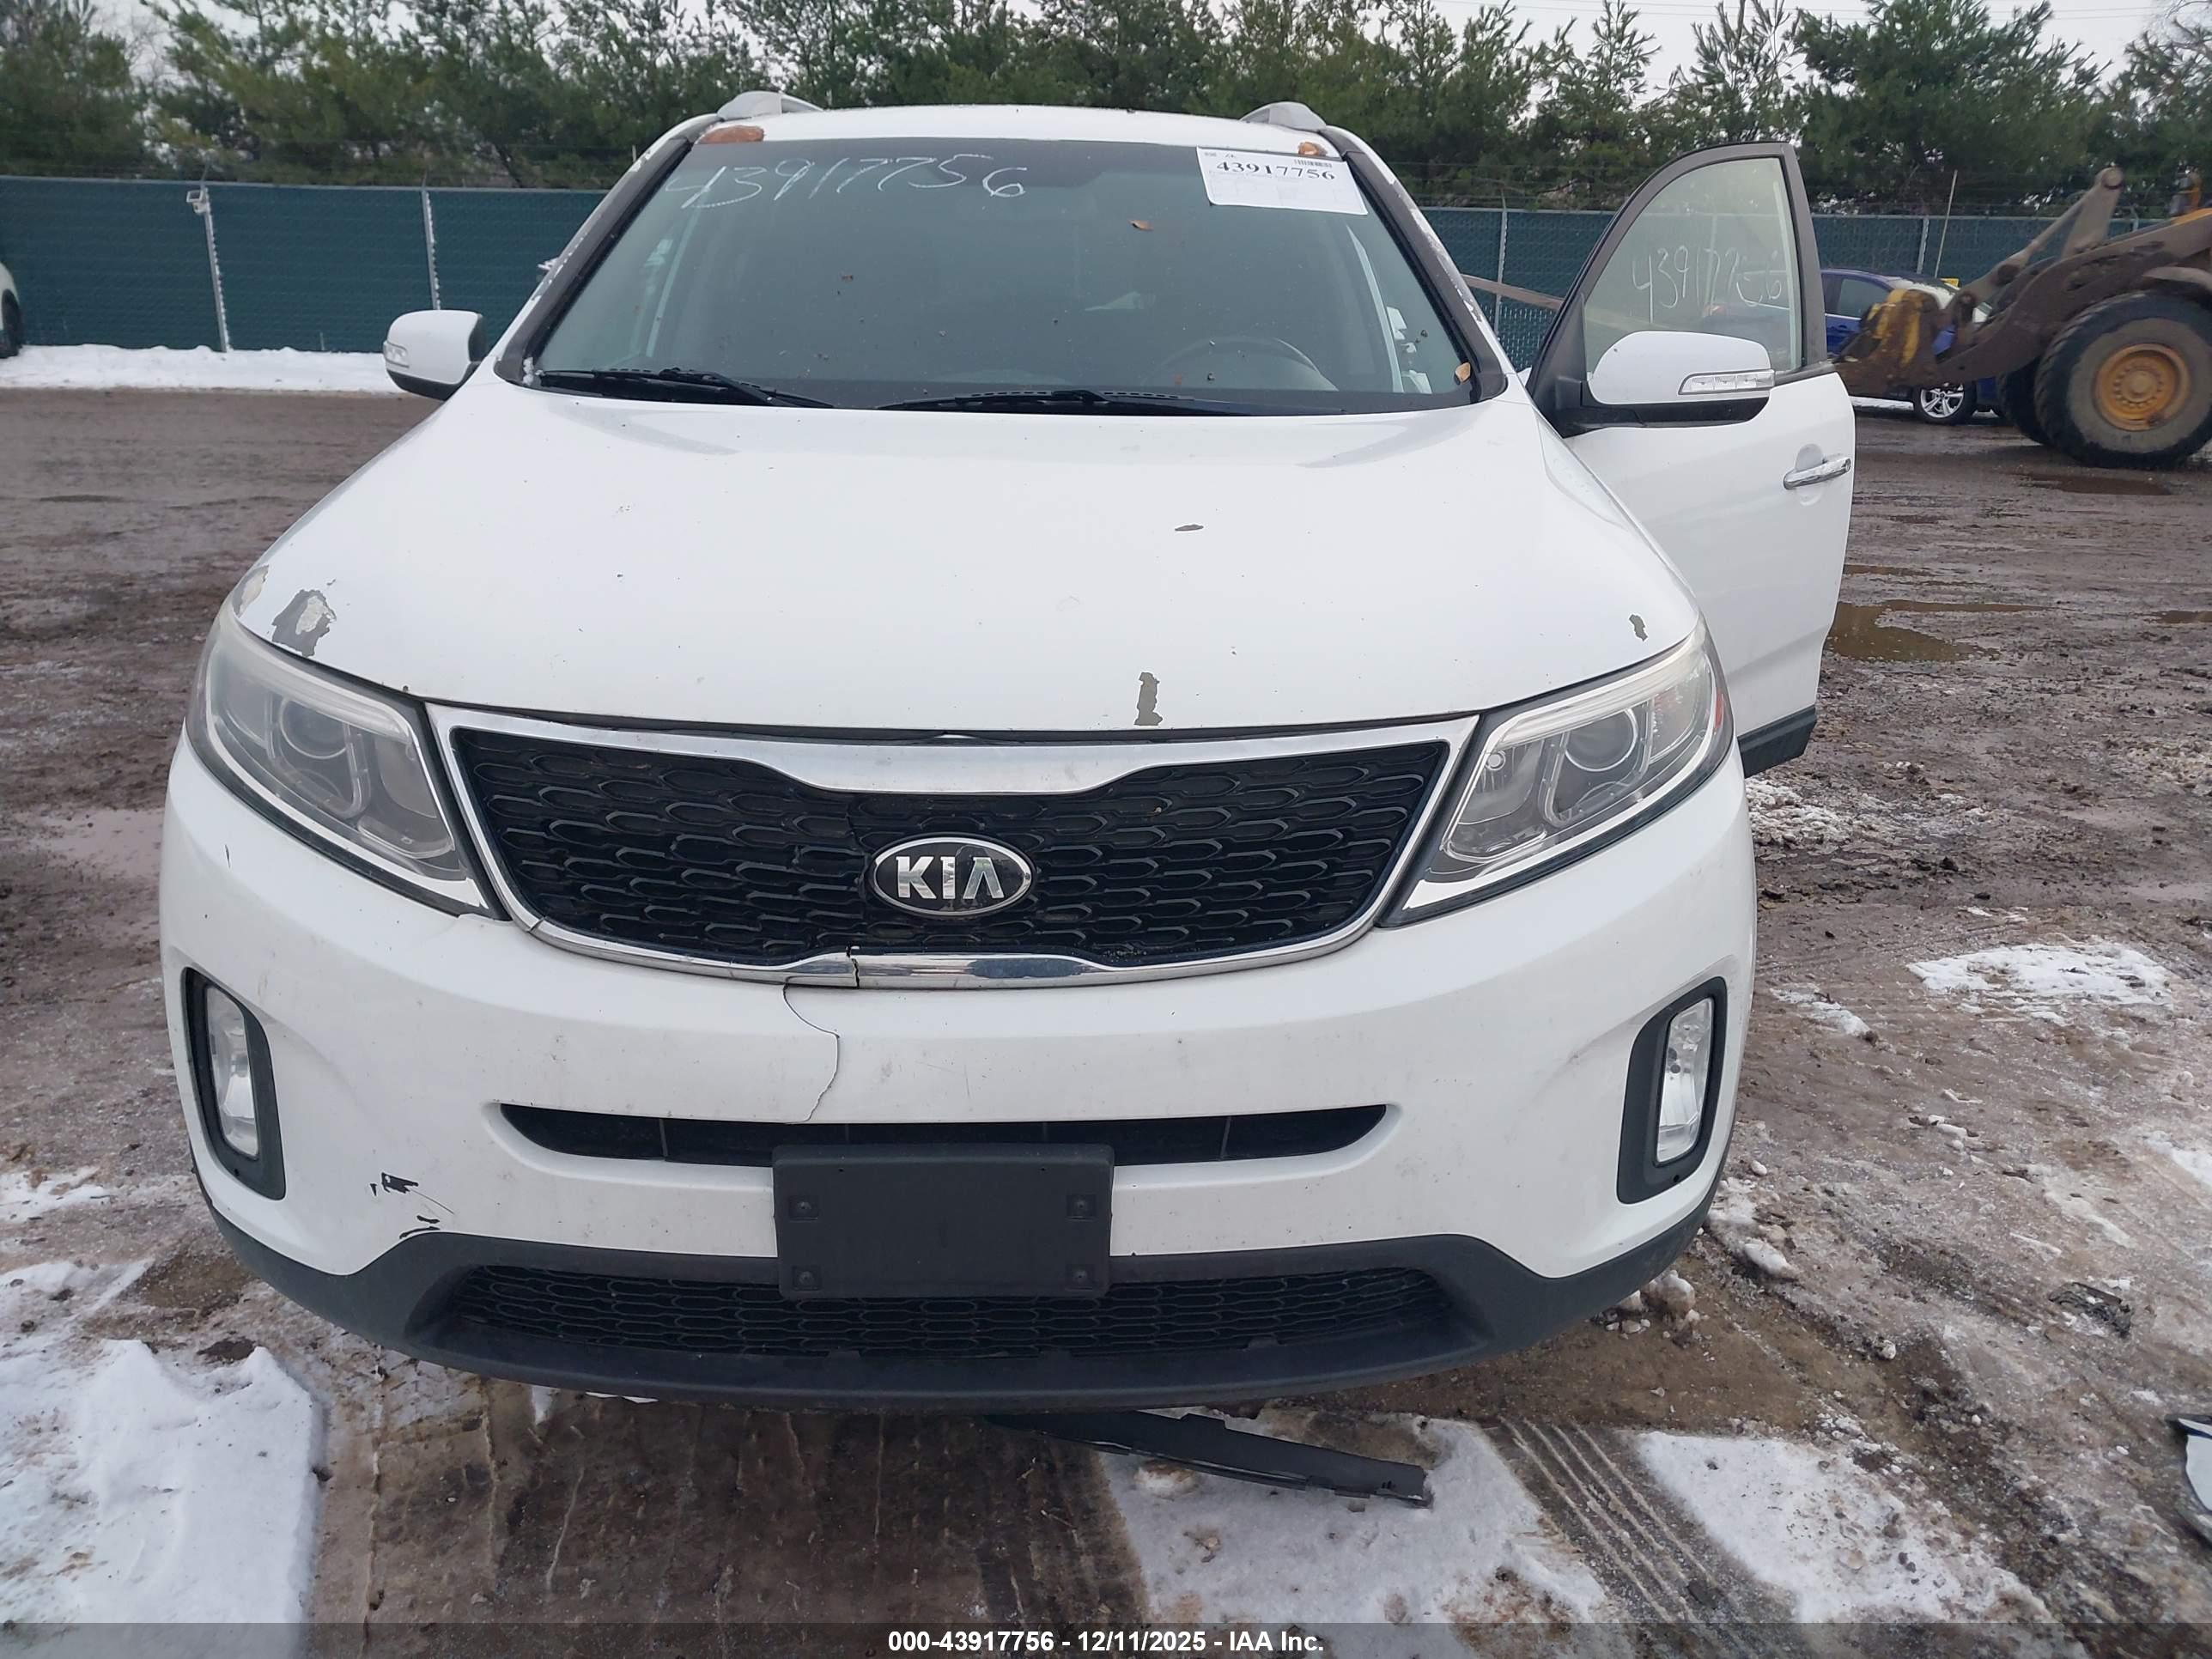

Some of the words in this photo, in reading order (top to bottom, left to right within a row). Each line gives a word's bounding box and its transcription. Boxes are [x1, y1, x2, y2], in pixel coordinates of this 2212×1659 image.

[665, 154, 1028, 210] 43917756
[1216, 161, 1335, 180] 43917756
[896, 856, 1005, 899] KIA
